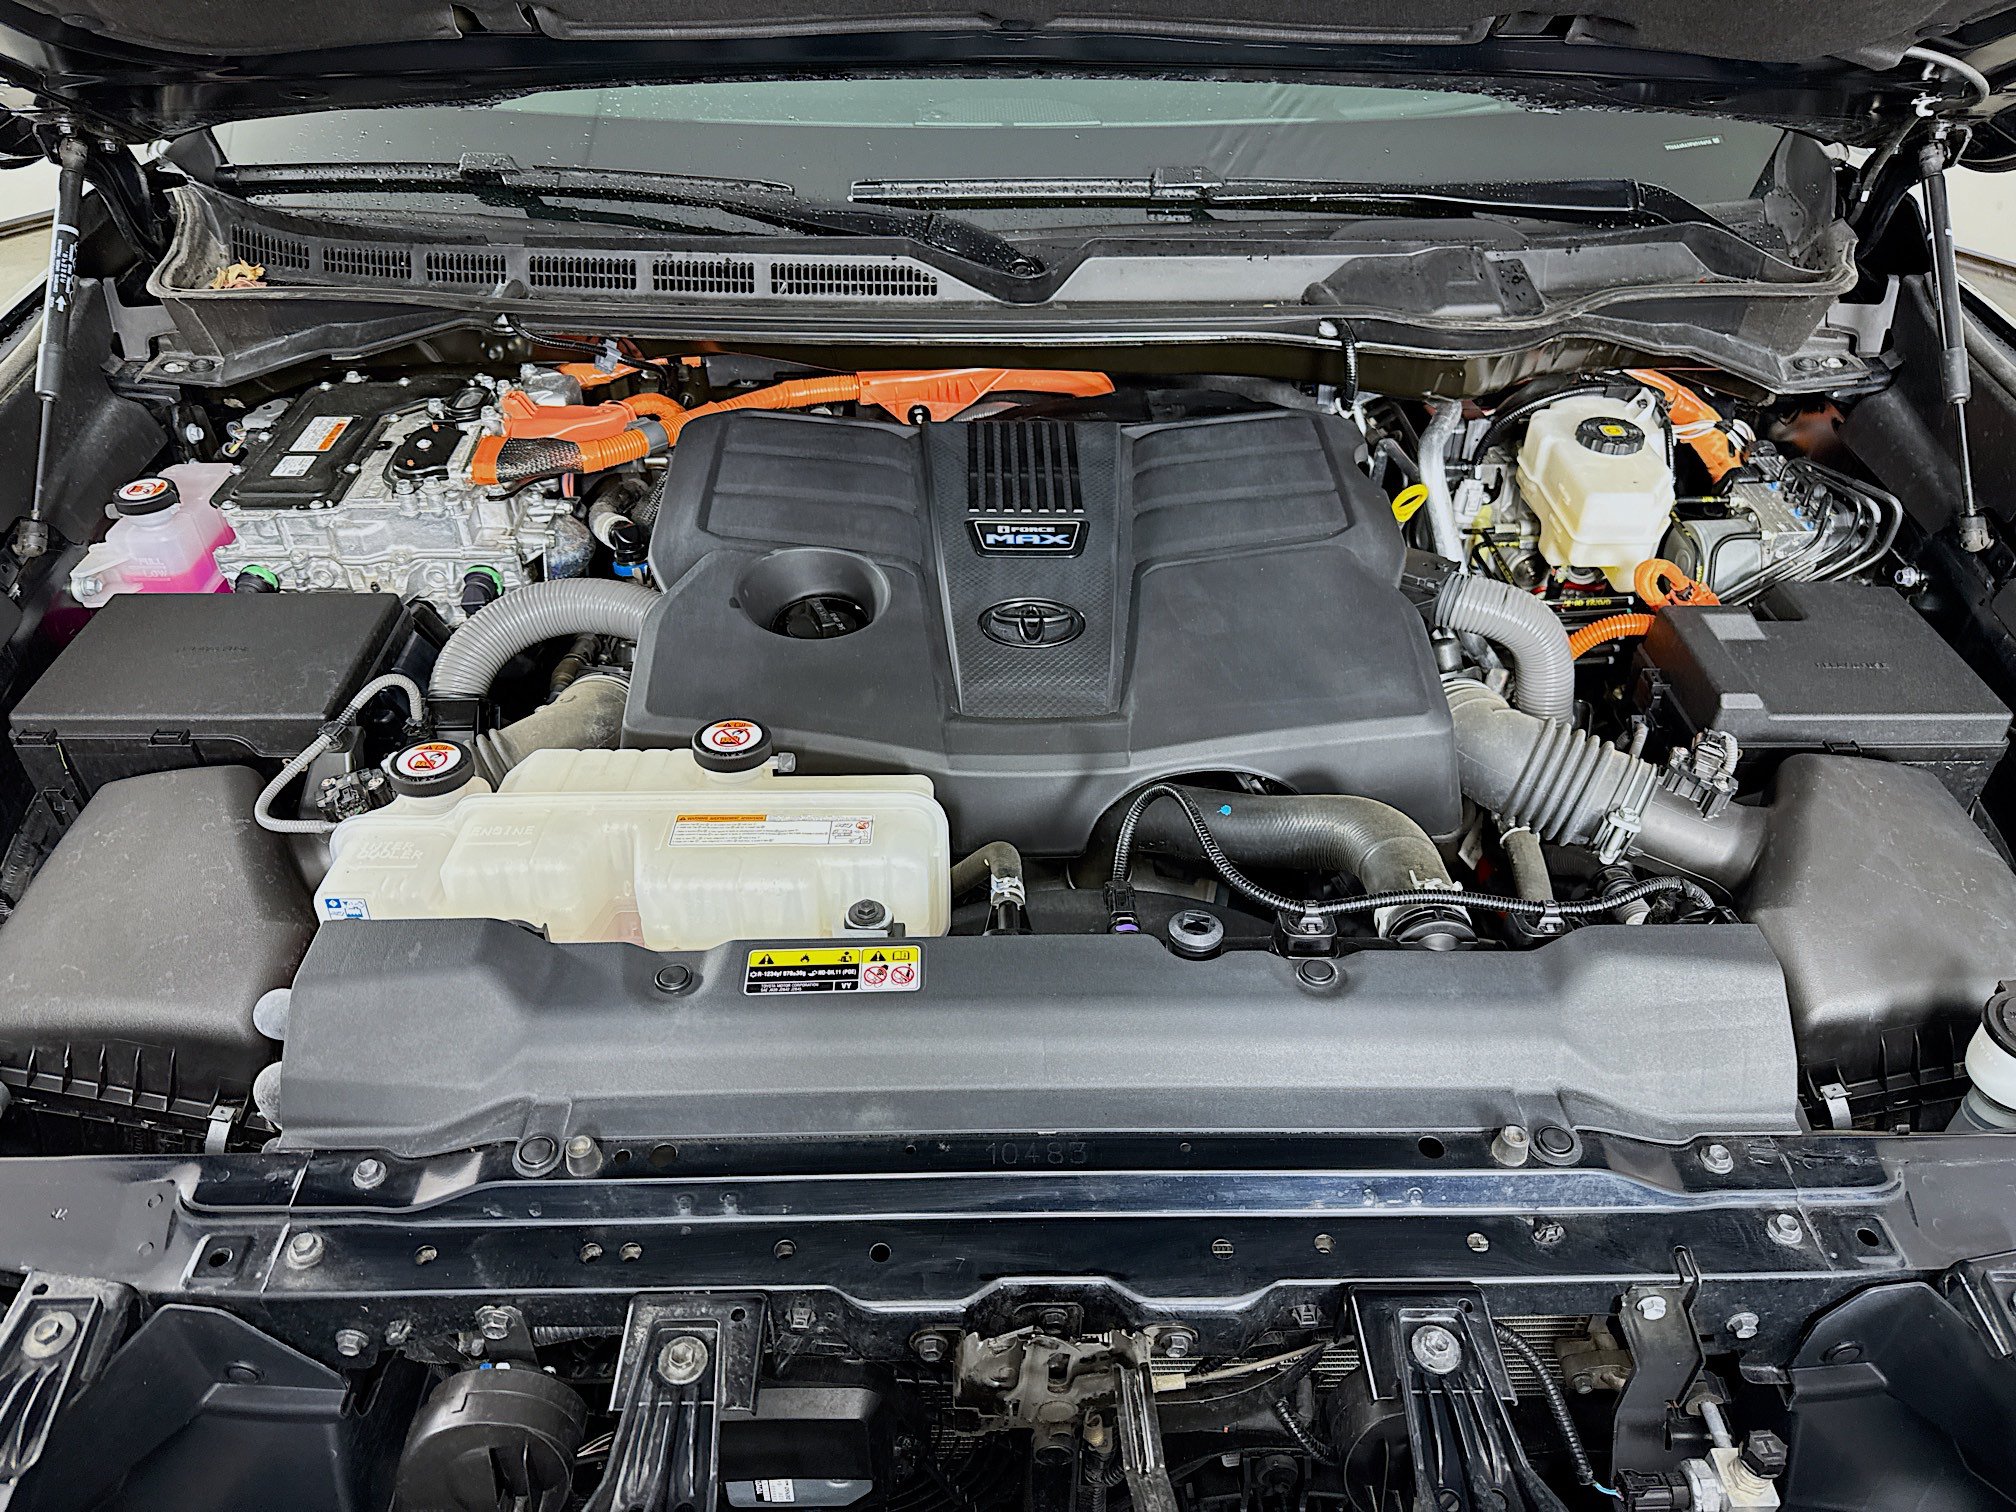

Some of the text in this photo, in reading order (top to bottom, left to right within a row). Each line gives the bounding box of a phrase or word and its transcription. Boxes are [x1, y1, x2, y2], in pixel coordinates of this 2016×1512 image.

[986, 534, 1070, 544] MAX
[471, 826, 535, 836] ENGINE
[985, 1141, 1088, 1165] 10483
